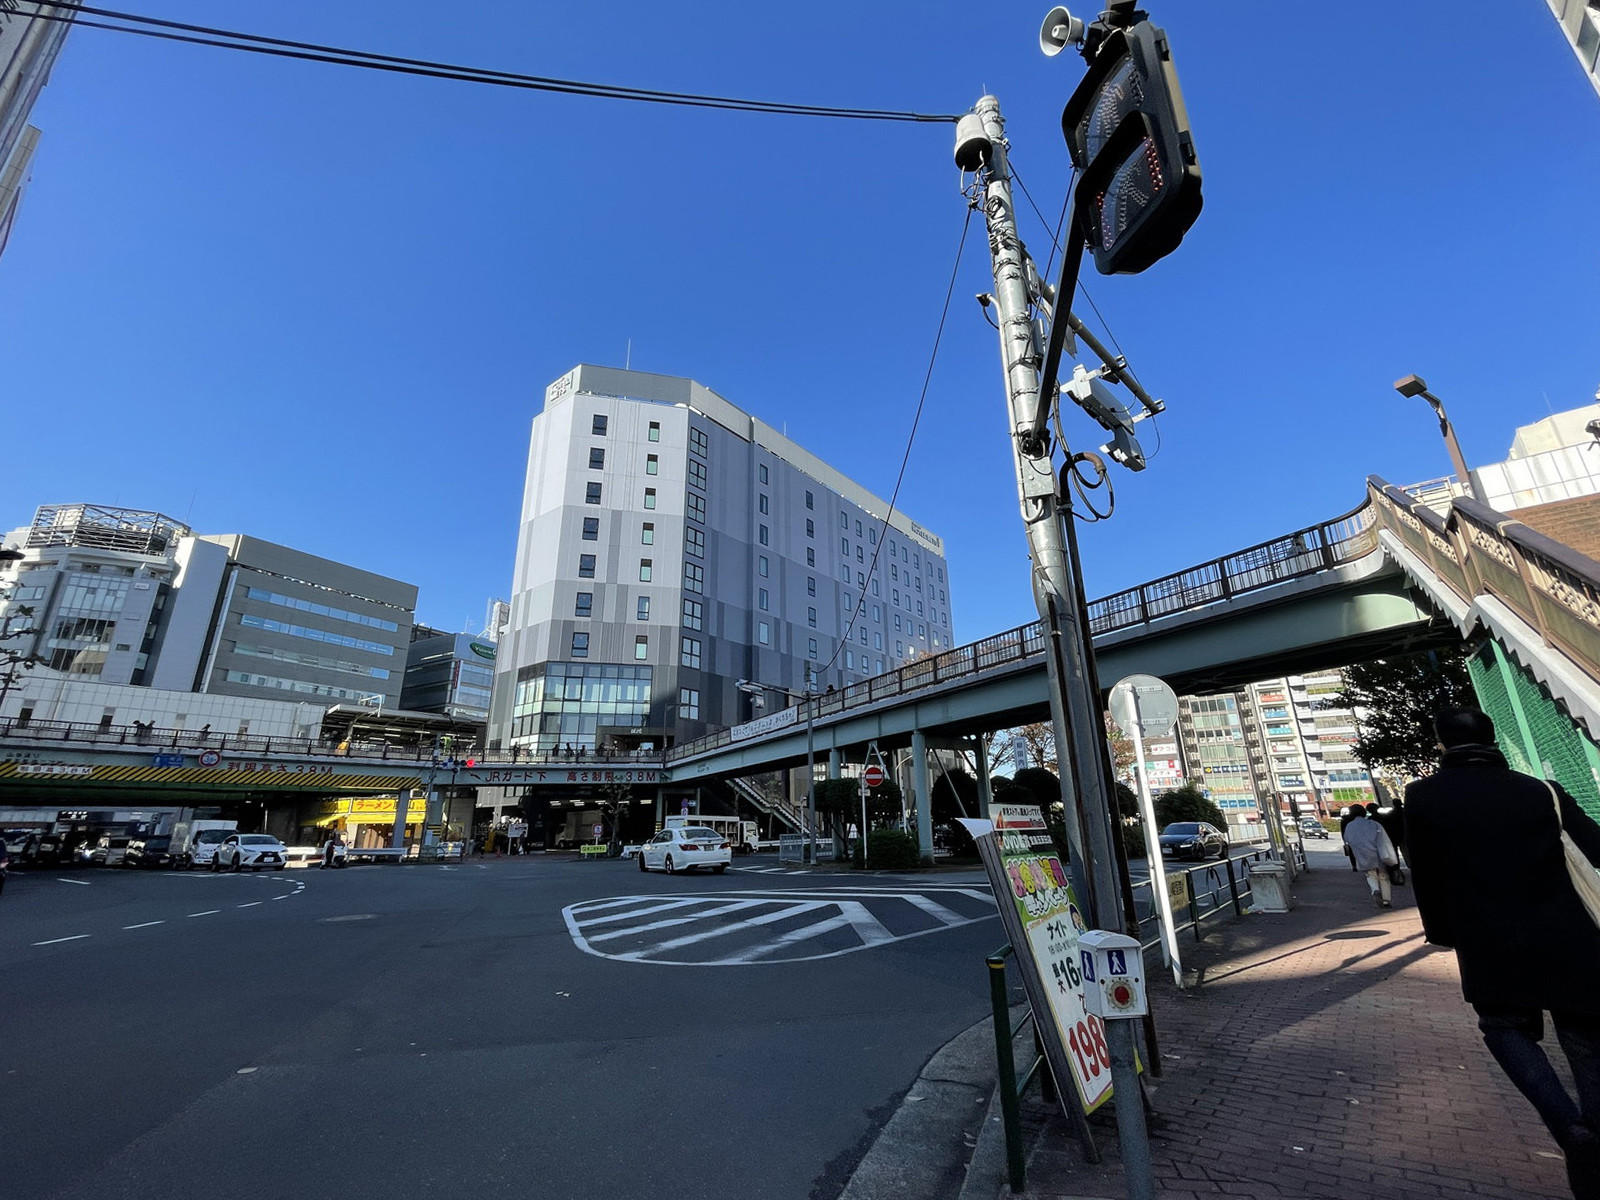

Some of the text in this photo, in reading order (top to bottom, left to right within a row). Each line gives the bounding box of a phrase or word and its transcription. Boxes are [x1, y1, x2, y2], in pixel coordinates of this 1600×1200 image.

[485, 771, 547, 782] JRガード下
[567, 771, 615, 782] 高さ制限
[356, 800, 392, 810] ラーメン
[1046, 920, 1067, 940] ナイト
[1060, 956, 1082, 989] 16
[1069, 1014, 1110, 1082] 198
